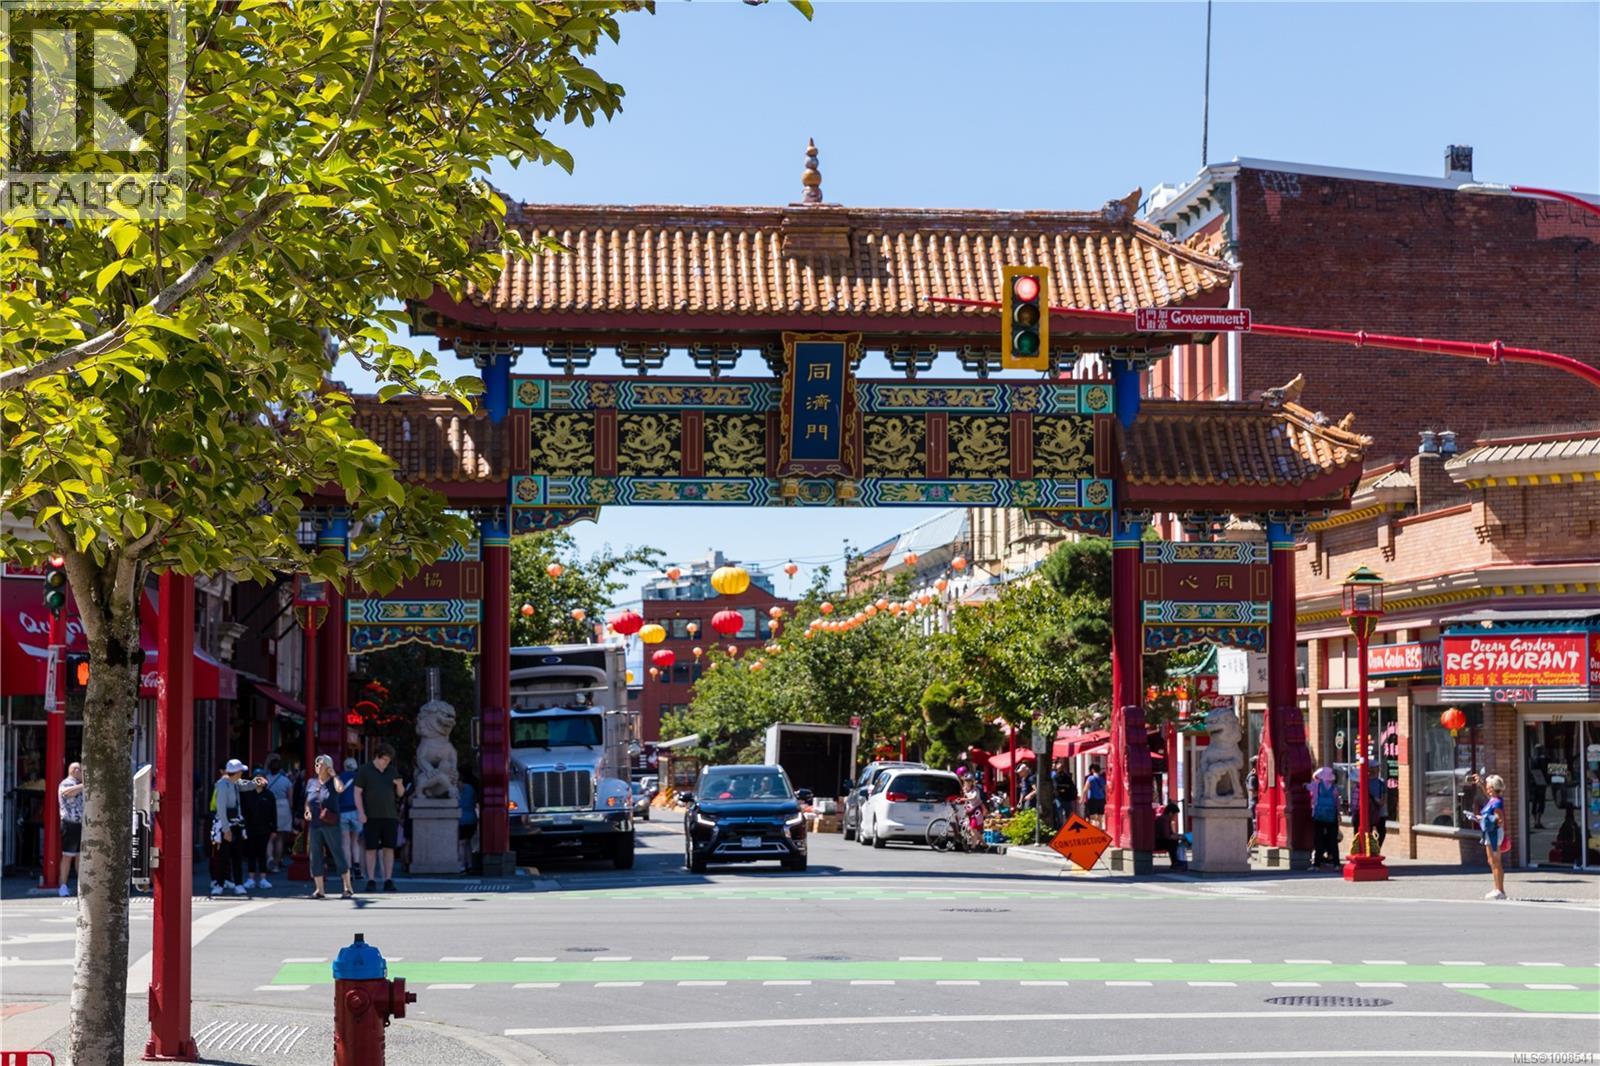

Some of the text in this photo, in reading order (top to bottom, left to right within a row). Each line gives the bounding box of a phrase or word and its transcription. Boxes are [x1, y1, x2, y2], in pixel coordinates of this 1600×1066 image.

[1171, 311, 1246, 325] Government
[1471, 636, 1555, 653] Ocean Garden
[1446, 651, 1580, 670] RESTAURANT
[1053, 836, 1108, 848] CONSTRUCTION
